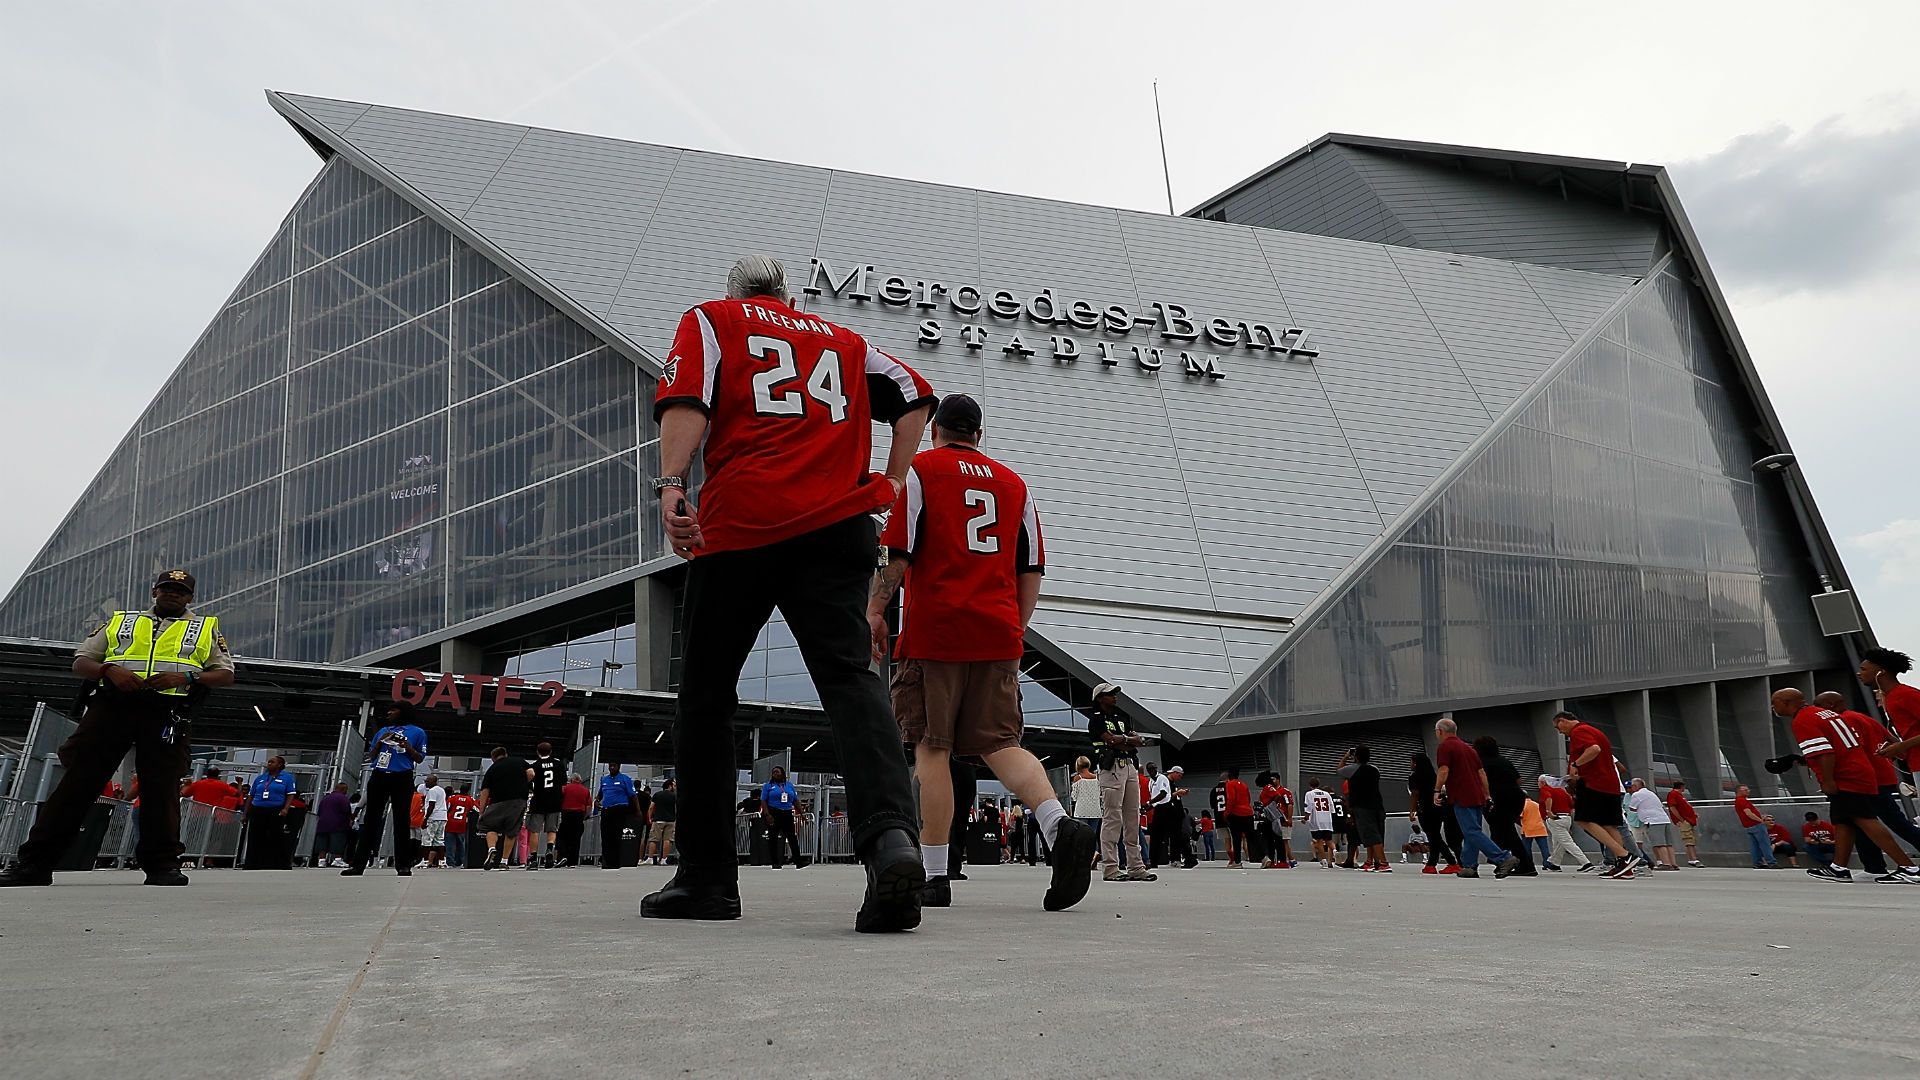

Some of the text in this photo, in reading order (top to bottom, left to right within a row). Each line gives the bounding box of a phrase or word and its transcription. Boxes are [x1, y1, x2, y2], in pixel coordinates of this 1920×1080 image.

[741, 303, 834, 337] FREEMAN
[802, 257, 1319, 358] Mercedes-Benz
[918, 319, 1226, 380] STADIUM
[747, 335, 848, 423] 24
[958, 460, 993, 478] RYAN
[390, 483, 438, 500] WELCOME
[964, 488, 998, 553] 2
[391, 668, 565, 716] GATE 2
[1829, 718, 1859, 749] 11
[543, 770, 554, 788] 2
[453, 805, 466, 820] 2
[1313, 797, 1330, 812] 33
